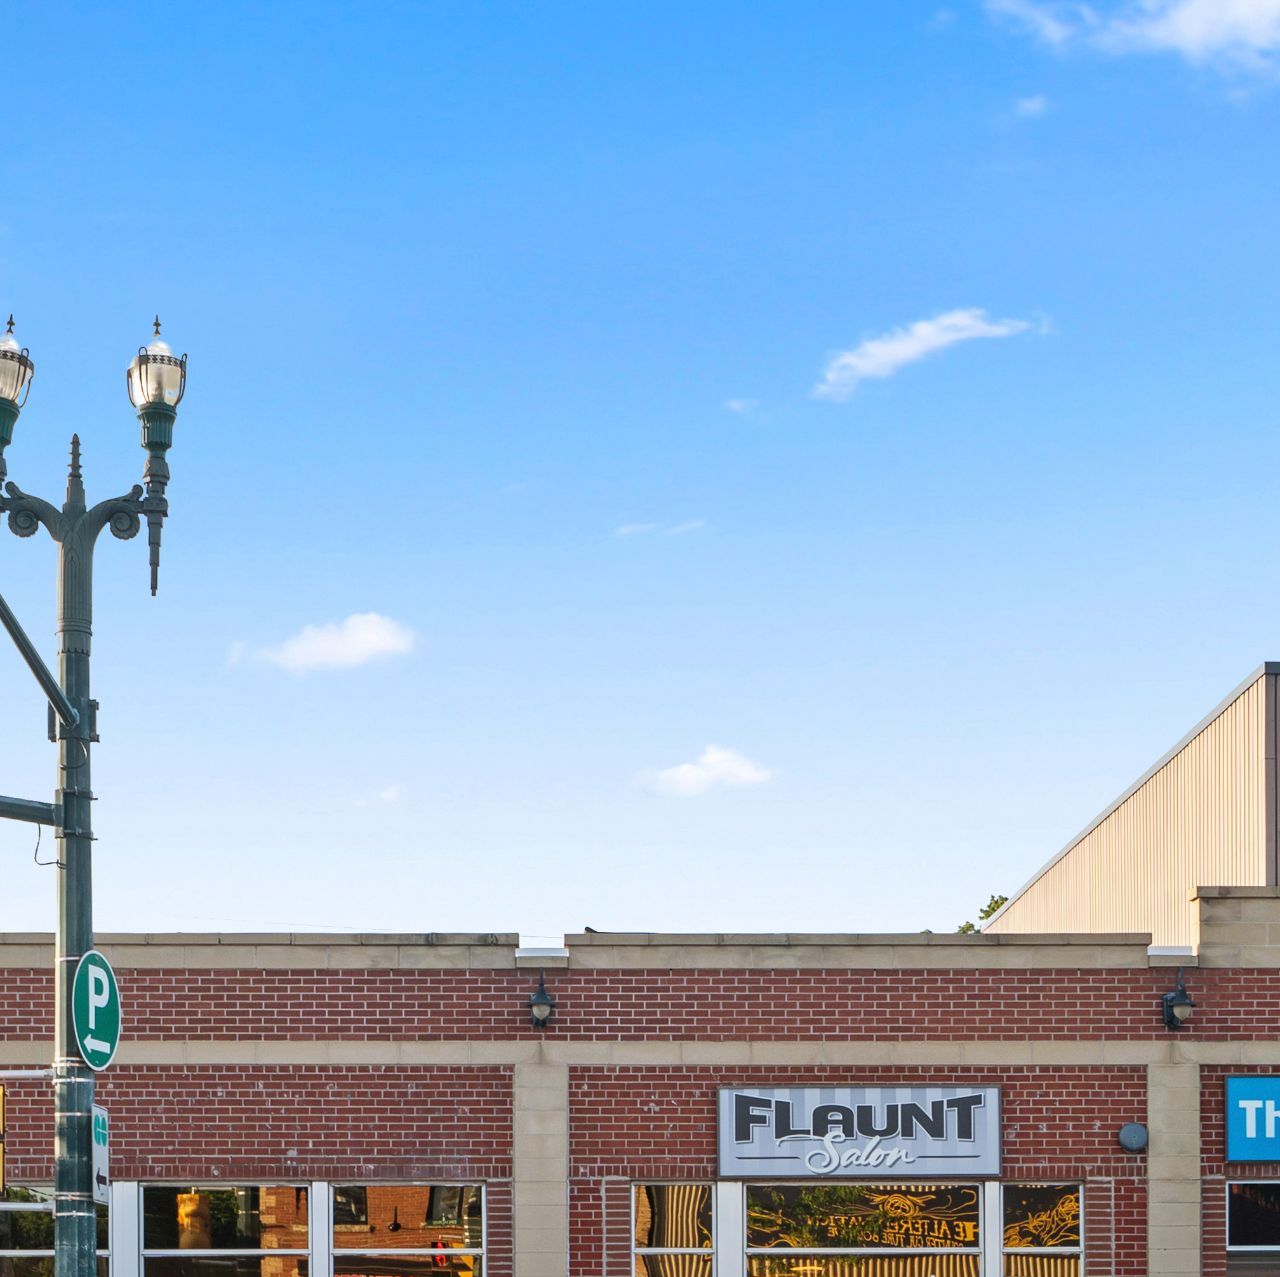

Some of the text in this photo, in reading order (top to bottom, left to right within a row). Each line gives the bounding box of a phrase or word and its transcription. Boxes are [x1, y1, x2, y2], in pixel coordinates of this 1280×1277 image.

[88, 963, 110, 1030] P
[734, 1092, 985, 1144] FLAUNT
[776, 1131, 918, 1174] Salon
